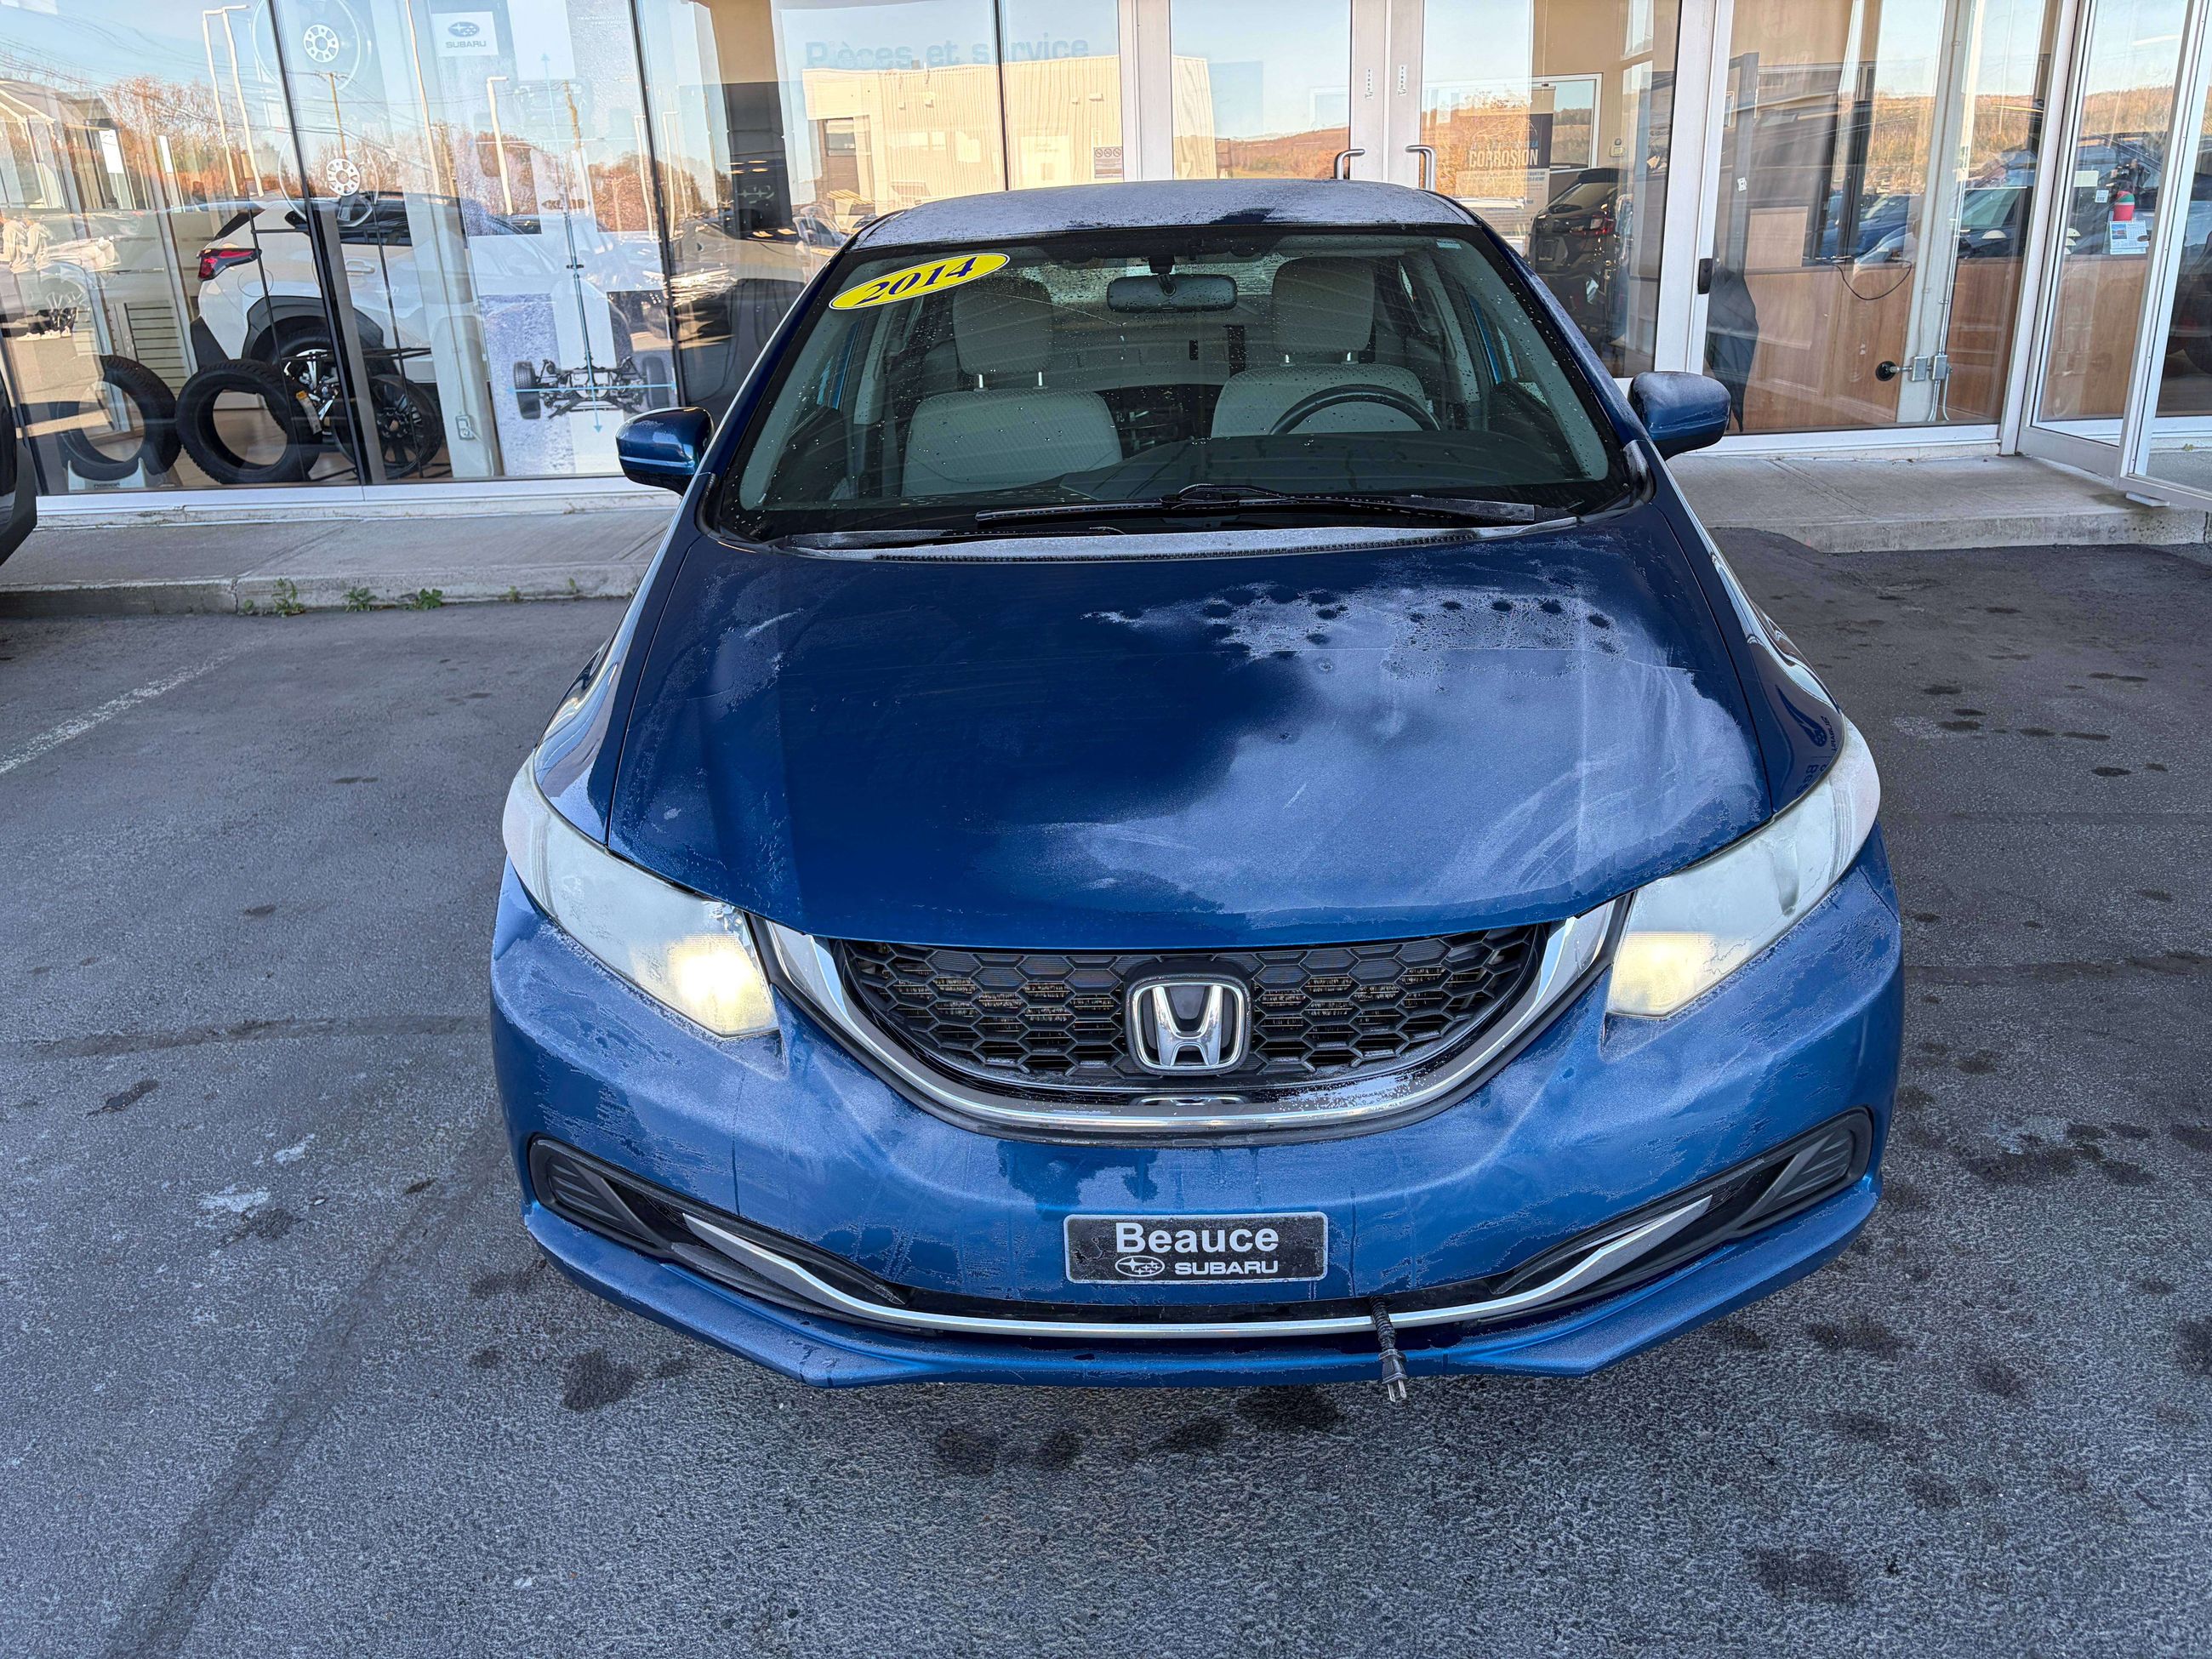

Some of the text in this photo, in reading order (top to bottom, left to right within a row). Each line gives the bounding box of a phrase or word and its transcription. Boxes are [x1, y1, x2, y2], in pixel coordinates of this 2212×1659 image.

[445, 40, 487, 48] SUBARU
[926, 40, 960, 68] et
[972, 32, 1088, 65] srvice
[1468, 148, 1539, 168] CORROSION
[852, 257, 978, 306] 2014
[1116, 1222, 1280, 1254] Beauce
[1174, 1260, 1279, 1275] SUBARU
